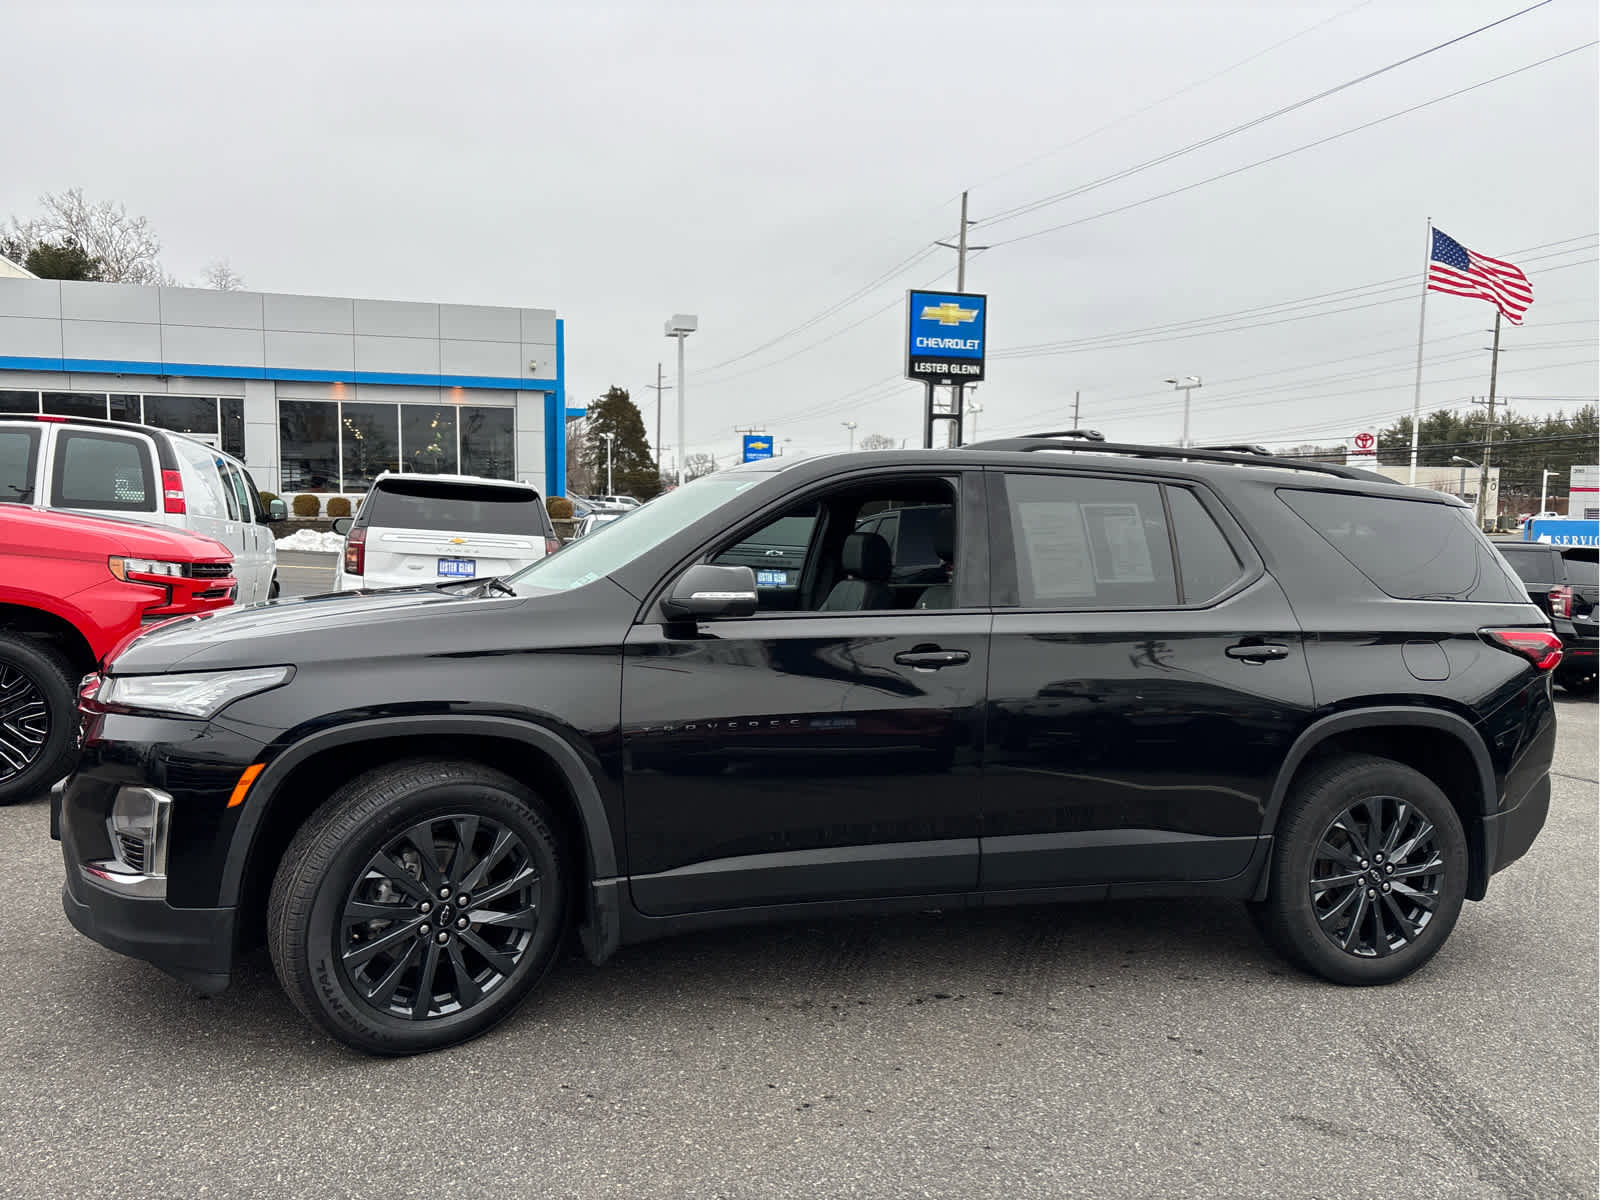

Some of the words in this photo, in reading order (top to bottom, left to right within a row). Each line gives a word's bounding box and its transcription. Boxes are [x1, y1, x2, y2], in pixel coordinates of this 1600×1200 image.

[916, 336, 979, 350] CHEVROLET
[914, 362, 948, 373] LESTER
[950, 363, 980, 375] GLENN
